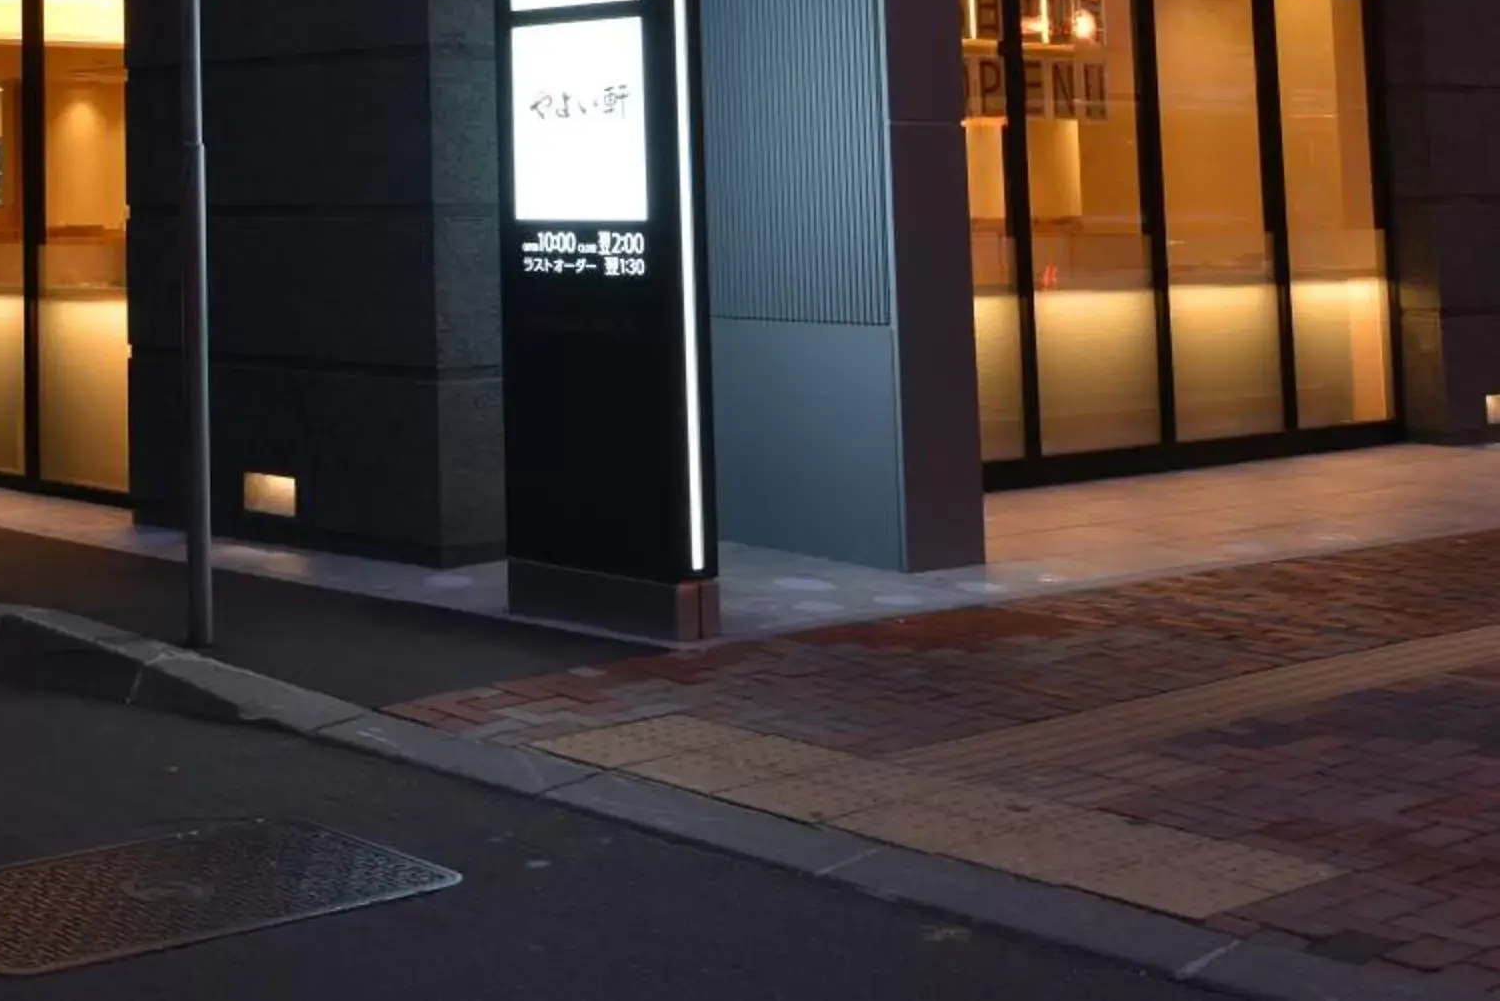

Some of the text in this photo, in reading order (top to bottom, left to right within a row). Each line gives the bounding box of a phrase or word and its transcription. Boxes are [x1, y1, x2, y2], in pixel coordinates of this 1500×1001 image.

[529, 84, 630, 120] やよい軒
[523, 257, 597, 274] ラストオーダー
